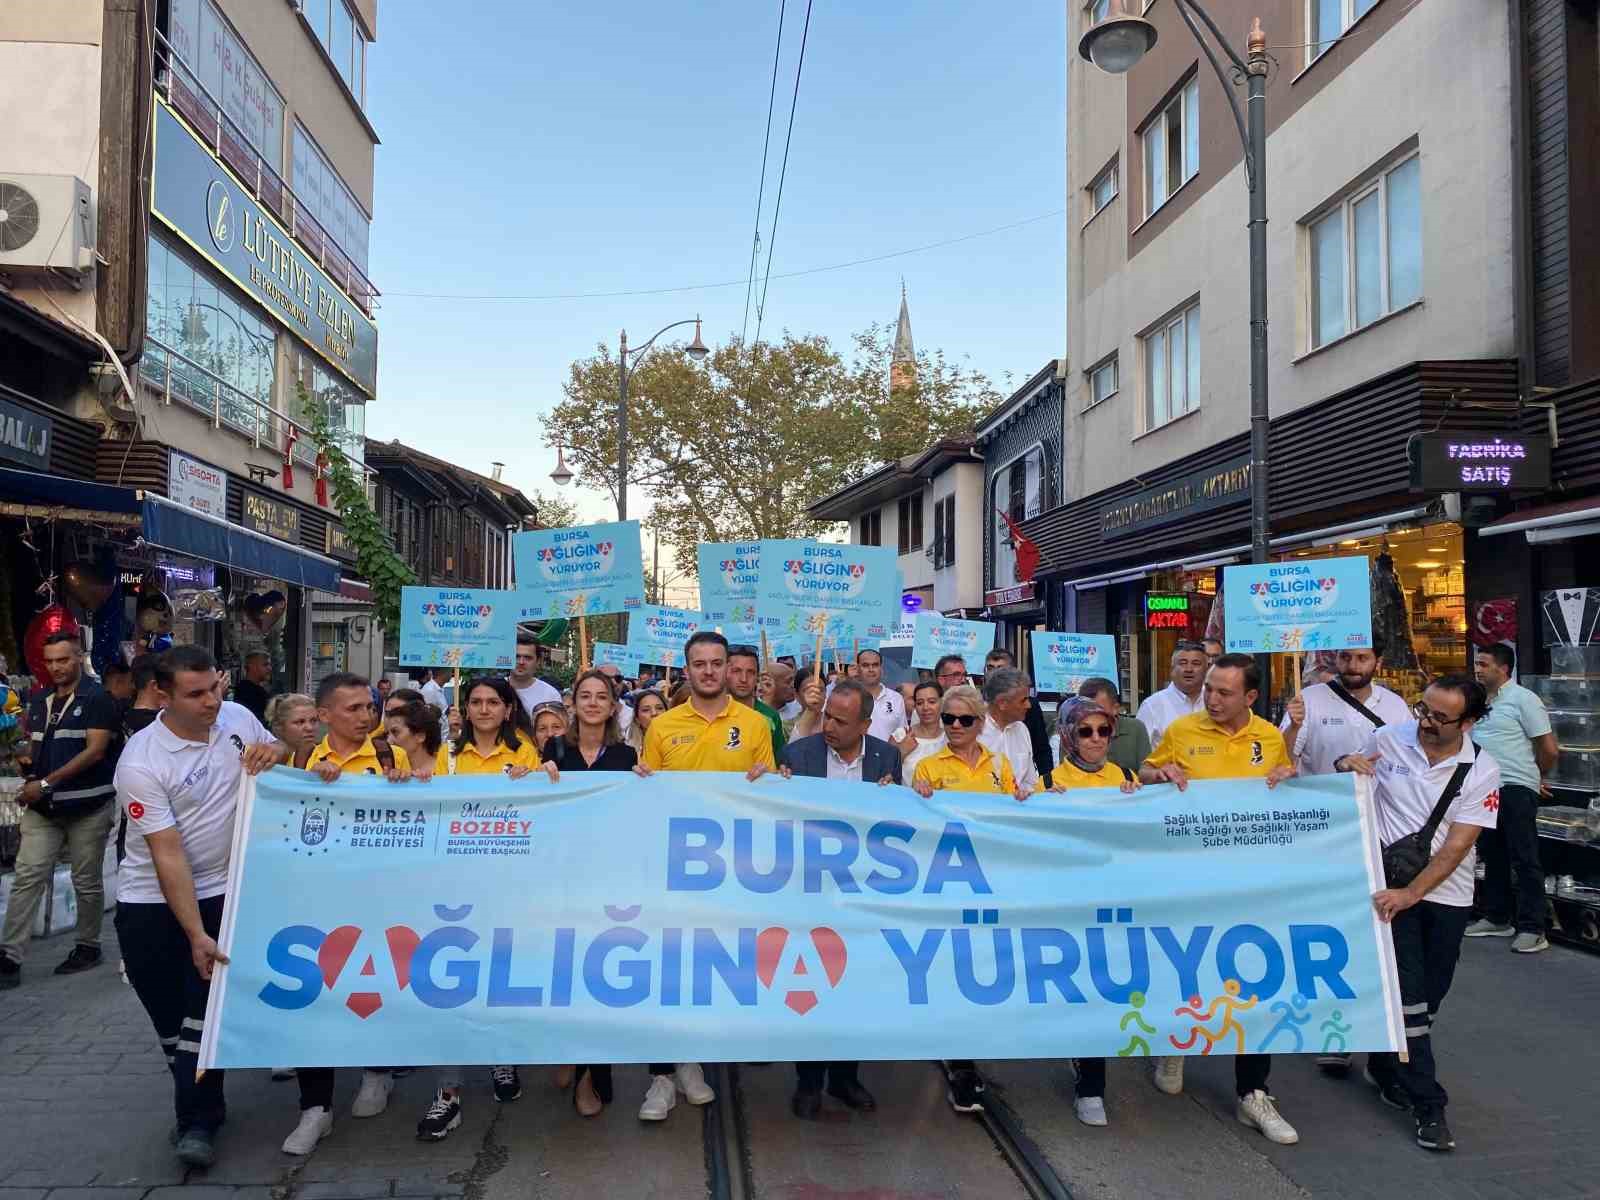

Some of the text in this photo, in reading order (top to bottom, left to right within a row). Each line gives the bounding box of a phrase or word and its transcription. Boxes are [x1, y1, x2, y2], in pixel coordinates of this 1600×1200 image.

[242, 208, 313, 307] LÜTFİYE
[317, 285, 356, 348] EZLEN
[1448, 438, 1526, 458] FABRİKA
[1203, 465, 1249, 497] AKTARİY
[554, 531, 589, 542] BURSA
[736, 546, 760, 554] BURS
[804, 547, 842, 558] BURSA
[720, 558, 760, 571] SAĞLI
[1270, 566, 1310, 577] BURSA
[732, 575, 758, 583] YÜRÜ
[795, 579, 849, 591] YÜRÜYOR
[440, 592, 472, 600] BURSA
[1148, 597, 1187, 609] OSMANLI
[1264, 597, 1322, 608] YÜRÜYOR
[1149, 613, 1187, 627] AKTAR
[353, 808, 426, 825] BURSA
[461, 802, 520, 822] Mustafa
[1164, 808, 1330, 826] Sağlık İşleri Dairesi Başkanlığı
[352, 825, 425, 837] BÜYÜKŞEHİR
[449, 821, 532, 834] BOZBEY
[1166, 821, 1329, 837] Halk Sağlığı ve Sağlıklı Yaşam
[350, 837, 424, 848] BELEDİYESİ
[447, 839, 530, 847] BURSA BÜYÜKŞEHİR
[1202, 834, 1293, 848] Şube Müdürlüğü
[446, 847, 530, 857] BELEDİYE BAŞKANI
[667, 817, 993, 894] BURSA
[258, 904, 1358, 1019] SAĞLIĞINA YÜRÜYOR
